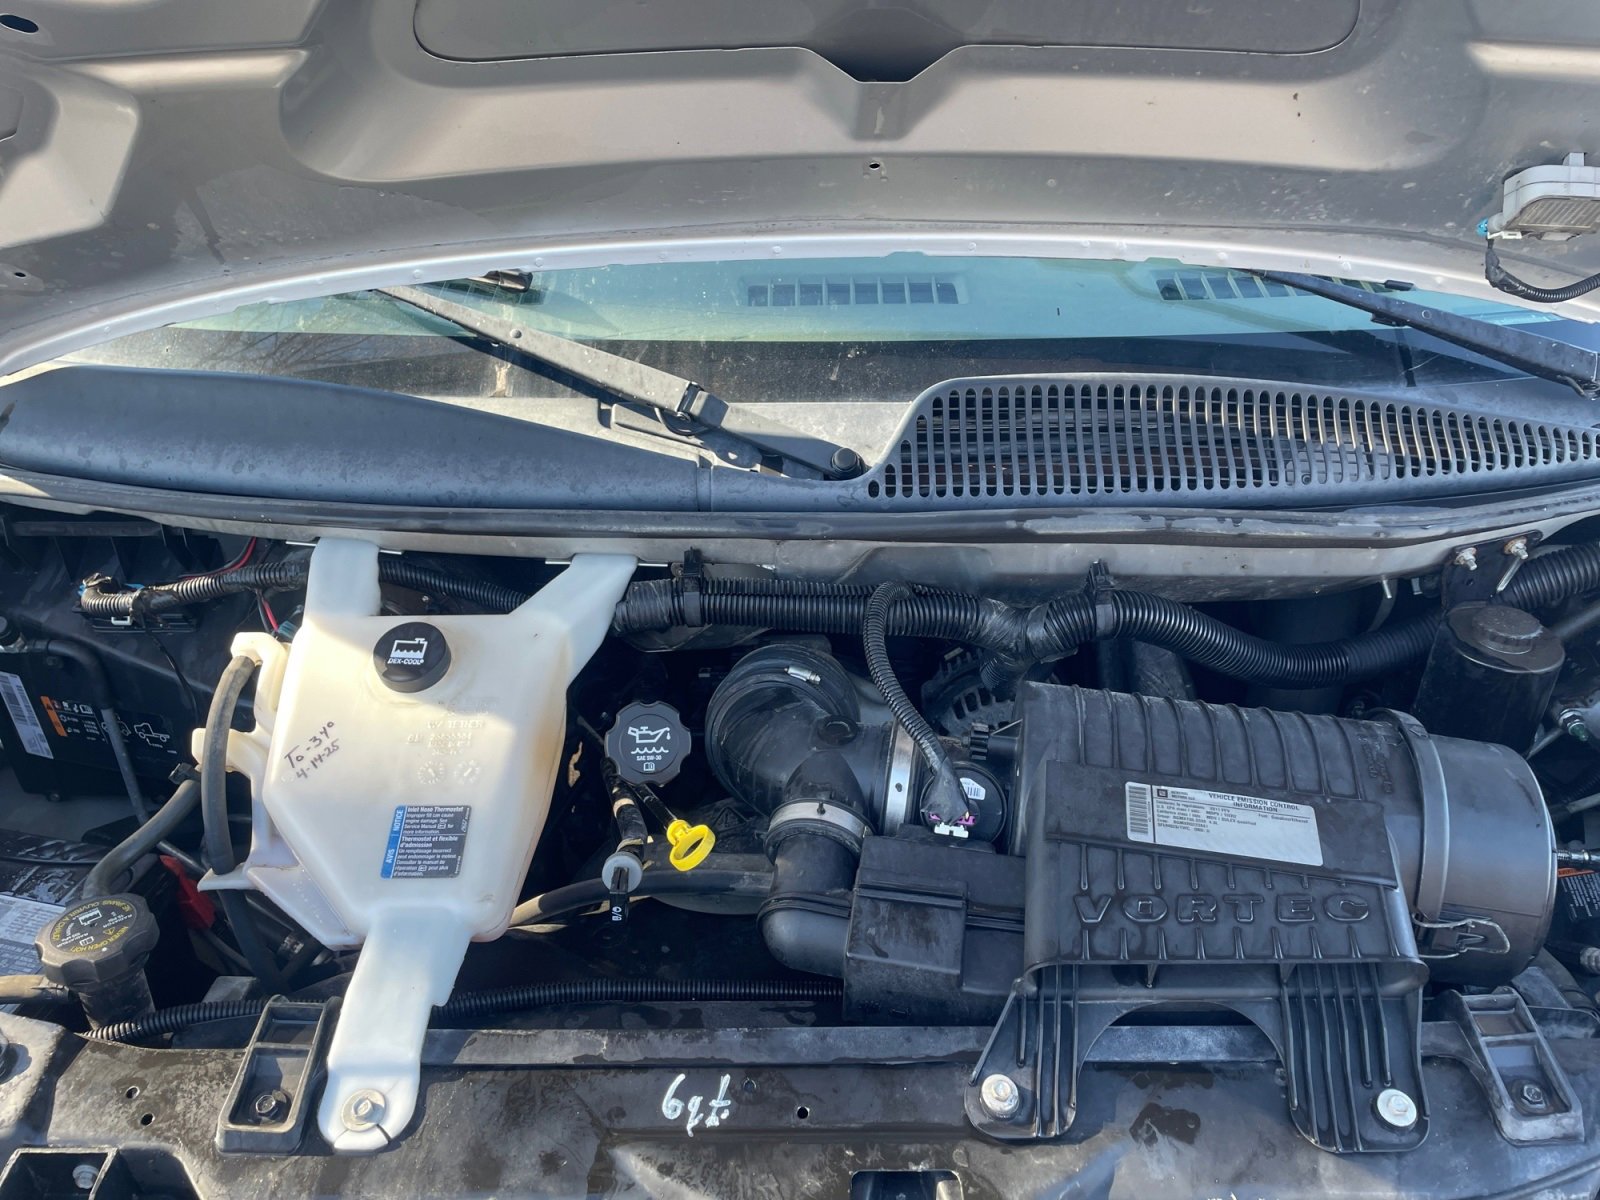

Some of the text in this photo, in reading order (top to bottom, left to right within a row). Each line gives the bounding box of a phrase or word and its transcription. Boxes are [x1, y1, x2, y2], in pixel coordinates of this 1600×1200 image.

[296, 738, 340, 779] 4-14-25
[1209, 793, 1299, 810] VEHICLE EMISSION CONTROL
[1233, 802, 1278, 812] INFORMATION
[394, 810, 404, 832] NOTICE
[386, 849, 395, 864] AVIS
[1073, 893, 1370, 923] VORTEC
[109, 926, 129, 942] NEVER
[88, 940, 108, 950] OPEN
